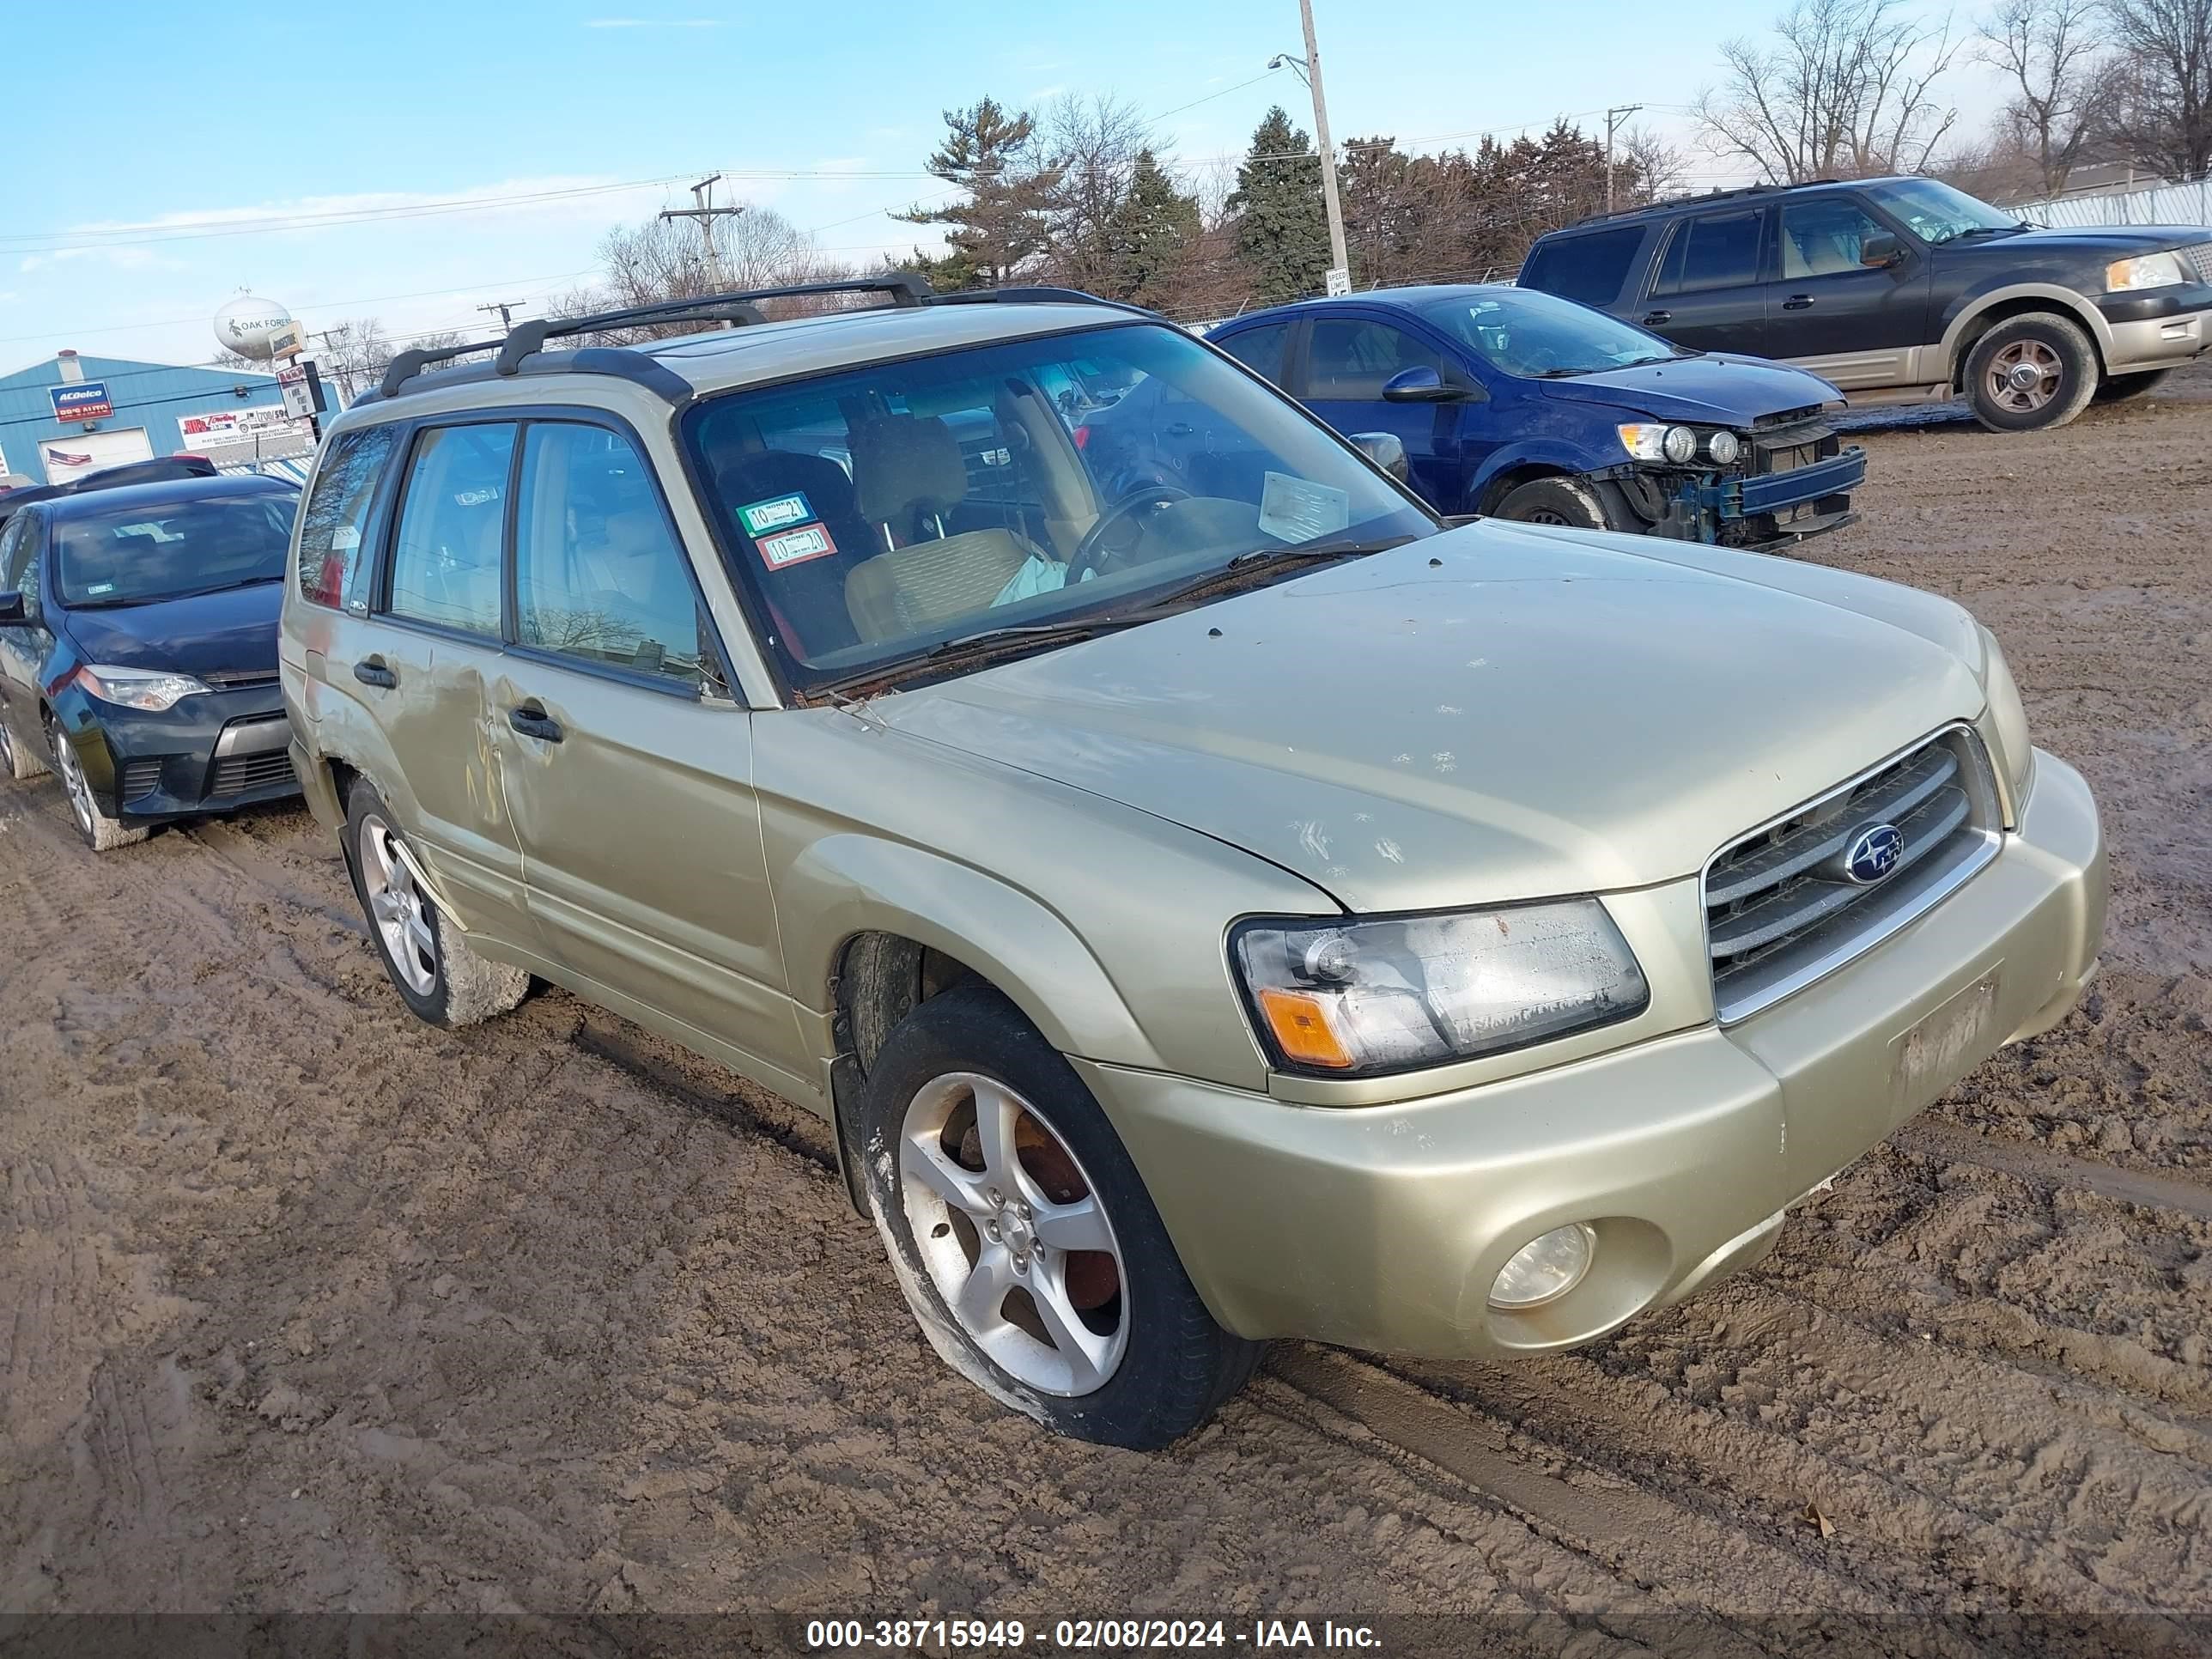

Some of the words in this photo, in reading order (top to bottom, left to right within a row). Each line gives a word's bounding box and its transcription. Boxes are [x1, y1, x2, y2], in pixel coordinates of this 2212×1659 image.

[1328, 271, 1346, 282] SPEED
[1331, 280, 1346, 289] LIMIT
[241, 320, 263, 331] OAK
[59, 390, 102, 401] ACDelco
[772, 540, 788, 559] 10
[806, 531, 824, 550] 20
